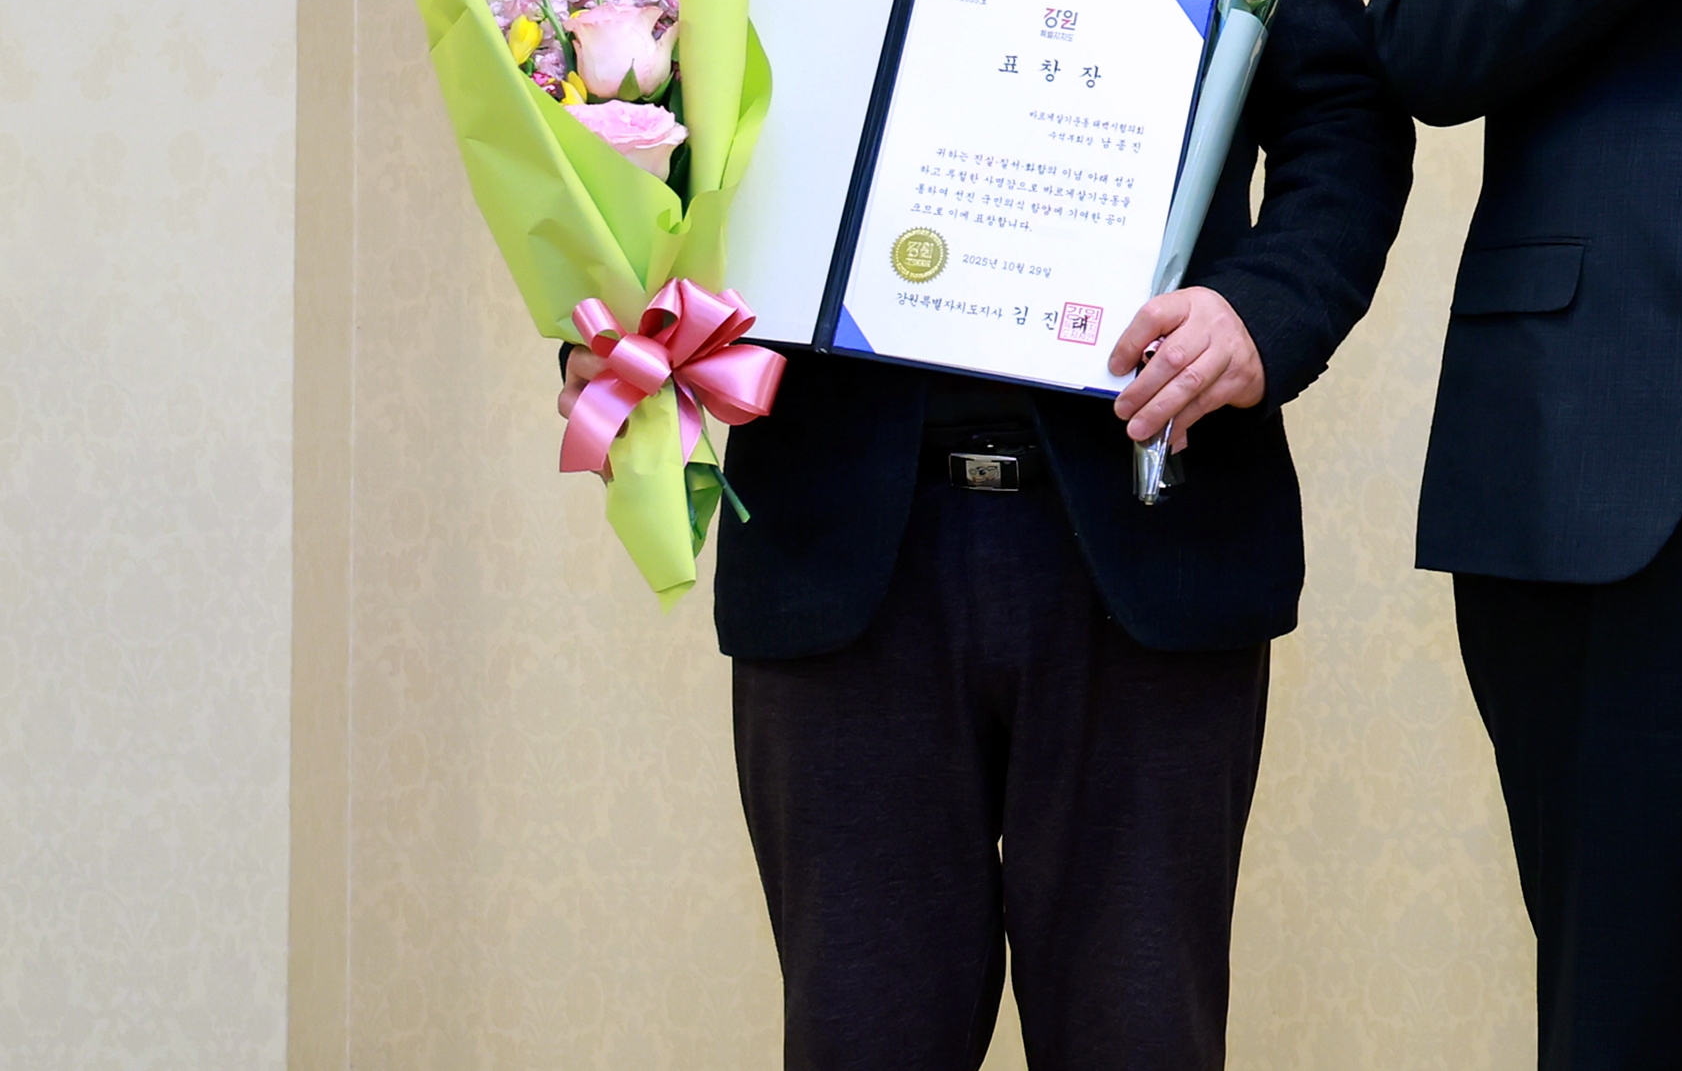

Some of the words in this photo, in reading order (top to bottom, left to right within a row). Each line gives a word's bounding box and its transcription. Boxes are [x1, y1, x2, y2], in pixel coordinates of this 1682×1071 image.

[1043, 7, 1078, 31] 강원
[936, 148, 968, 162] 귀하는
[1088, 172, 1108, 184] 아래
[920, 165, 940, 176] 하고
[985, 176, 1038, 192] 사명감으로
[1043, 185, 1131, 208] 바르게살기운동을
[910, 203, 943, 216] 크므로
[949, 209, 969, 220] 이에
[915, 183, 948, 197] 통하여
[955, 190, 975, 203] 선진
[981, 194, 1025, 210] 국민의식
[1068, 209, 1101, 223] 기여한
[1105, 214, 1126, 227] 공이
[962, 254, 998, 269] 2025년
[1002, 261, 1025, 274] 10월
[1029, 265, 1052, 278] 29일
[896, 292, 1003, 319] 강원특별자치도지사
